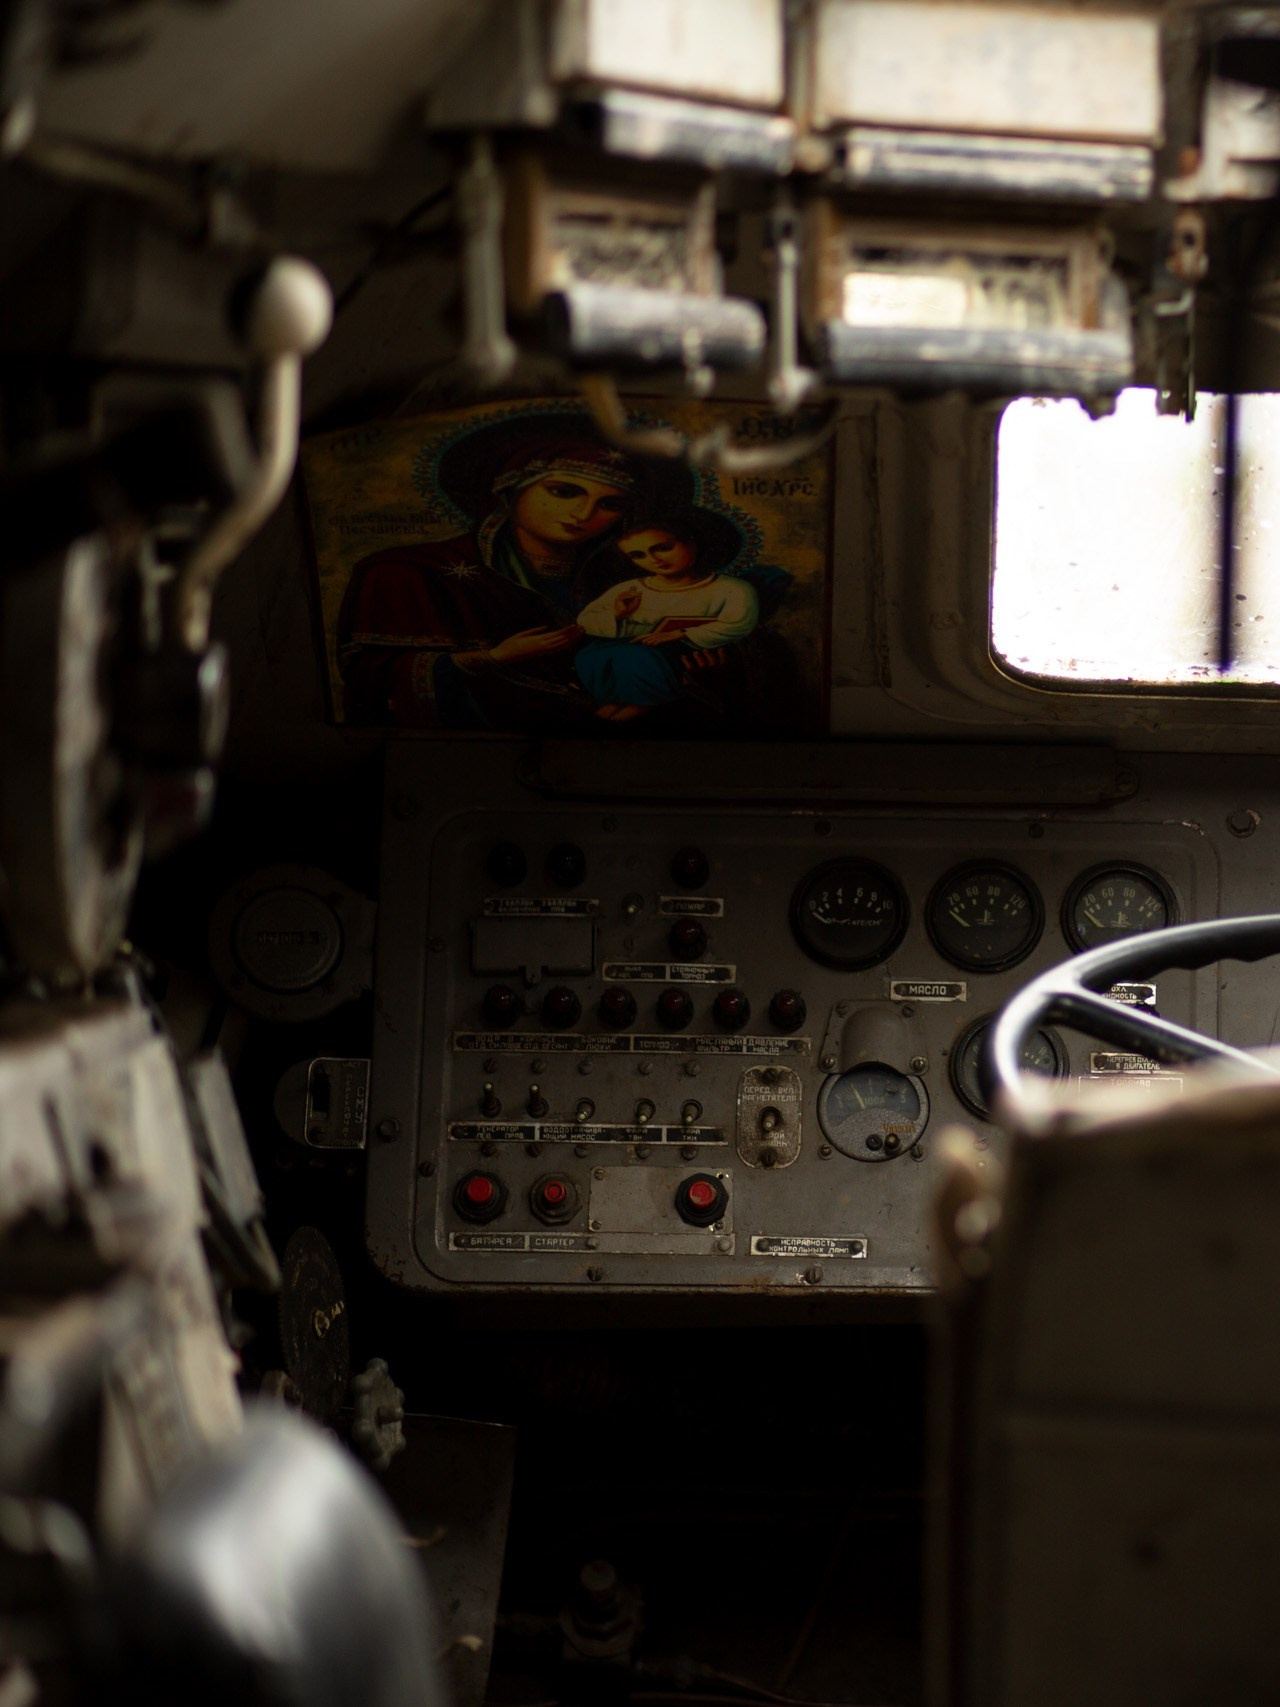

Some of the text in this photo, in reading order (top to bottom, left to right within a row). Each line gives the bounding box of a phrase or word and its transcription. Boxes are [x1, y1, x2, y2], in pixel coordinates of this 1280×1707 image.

[821, 891, 829, 902] 2
[836, 887, 844, 898] 4
[856, 887, 864, 898] 6
[871, 891, 878, 902] 8
[965, 885, 979, 897] 60
[1101, 886, 1115, 899] 60
[809, 899, 817, 911] 0
[882, 899, 894, 911] 10
[908, 984, 947, 996] МАСЛО
[696, 1038, 743, 1046] МАСЛЯНЫЙ
[747, 1039, 790, 1047] ДАВЛЕНИЕ
[744, 1086, 771, 1094] ПЕРЕД
[570, 1133, 597, 1141] НАСОС
[470, 1237, 512, 1246] БАТАРЕЯ
[535, 1237, 575, 1246] СТАРТЕР
[781, 1239, 836, 1247] ИСПРАВНОСТЬ
[769, 1245, 824, 1253] КОНТРОЛЬНЫХ
